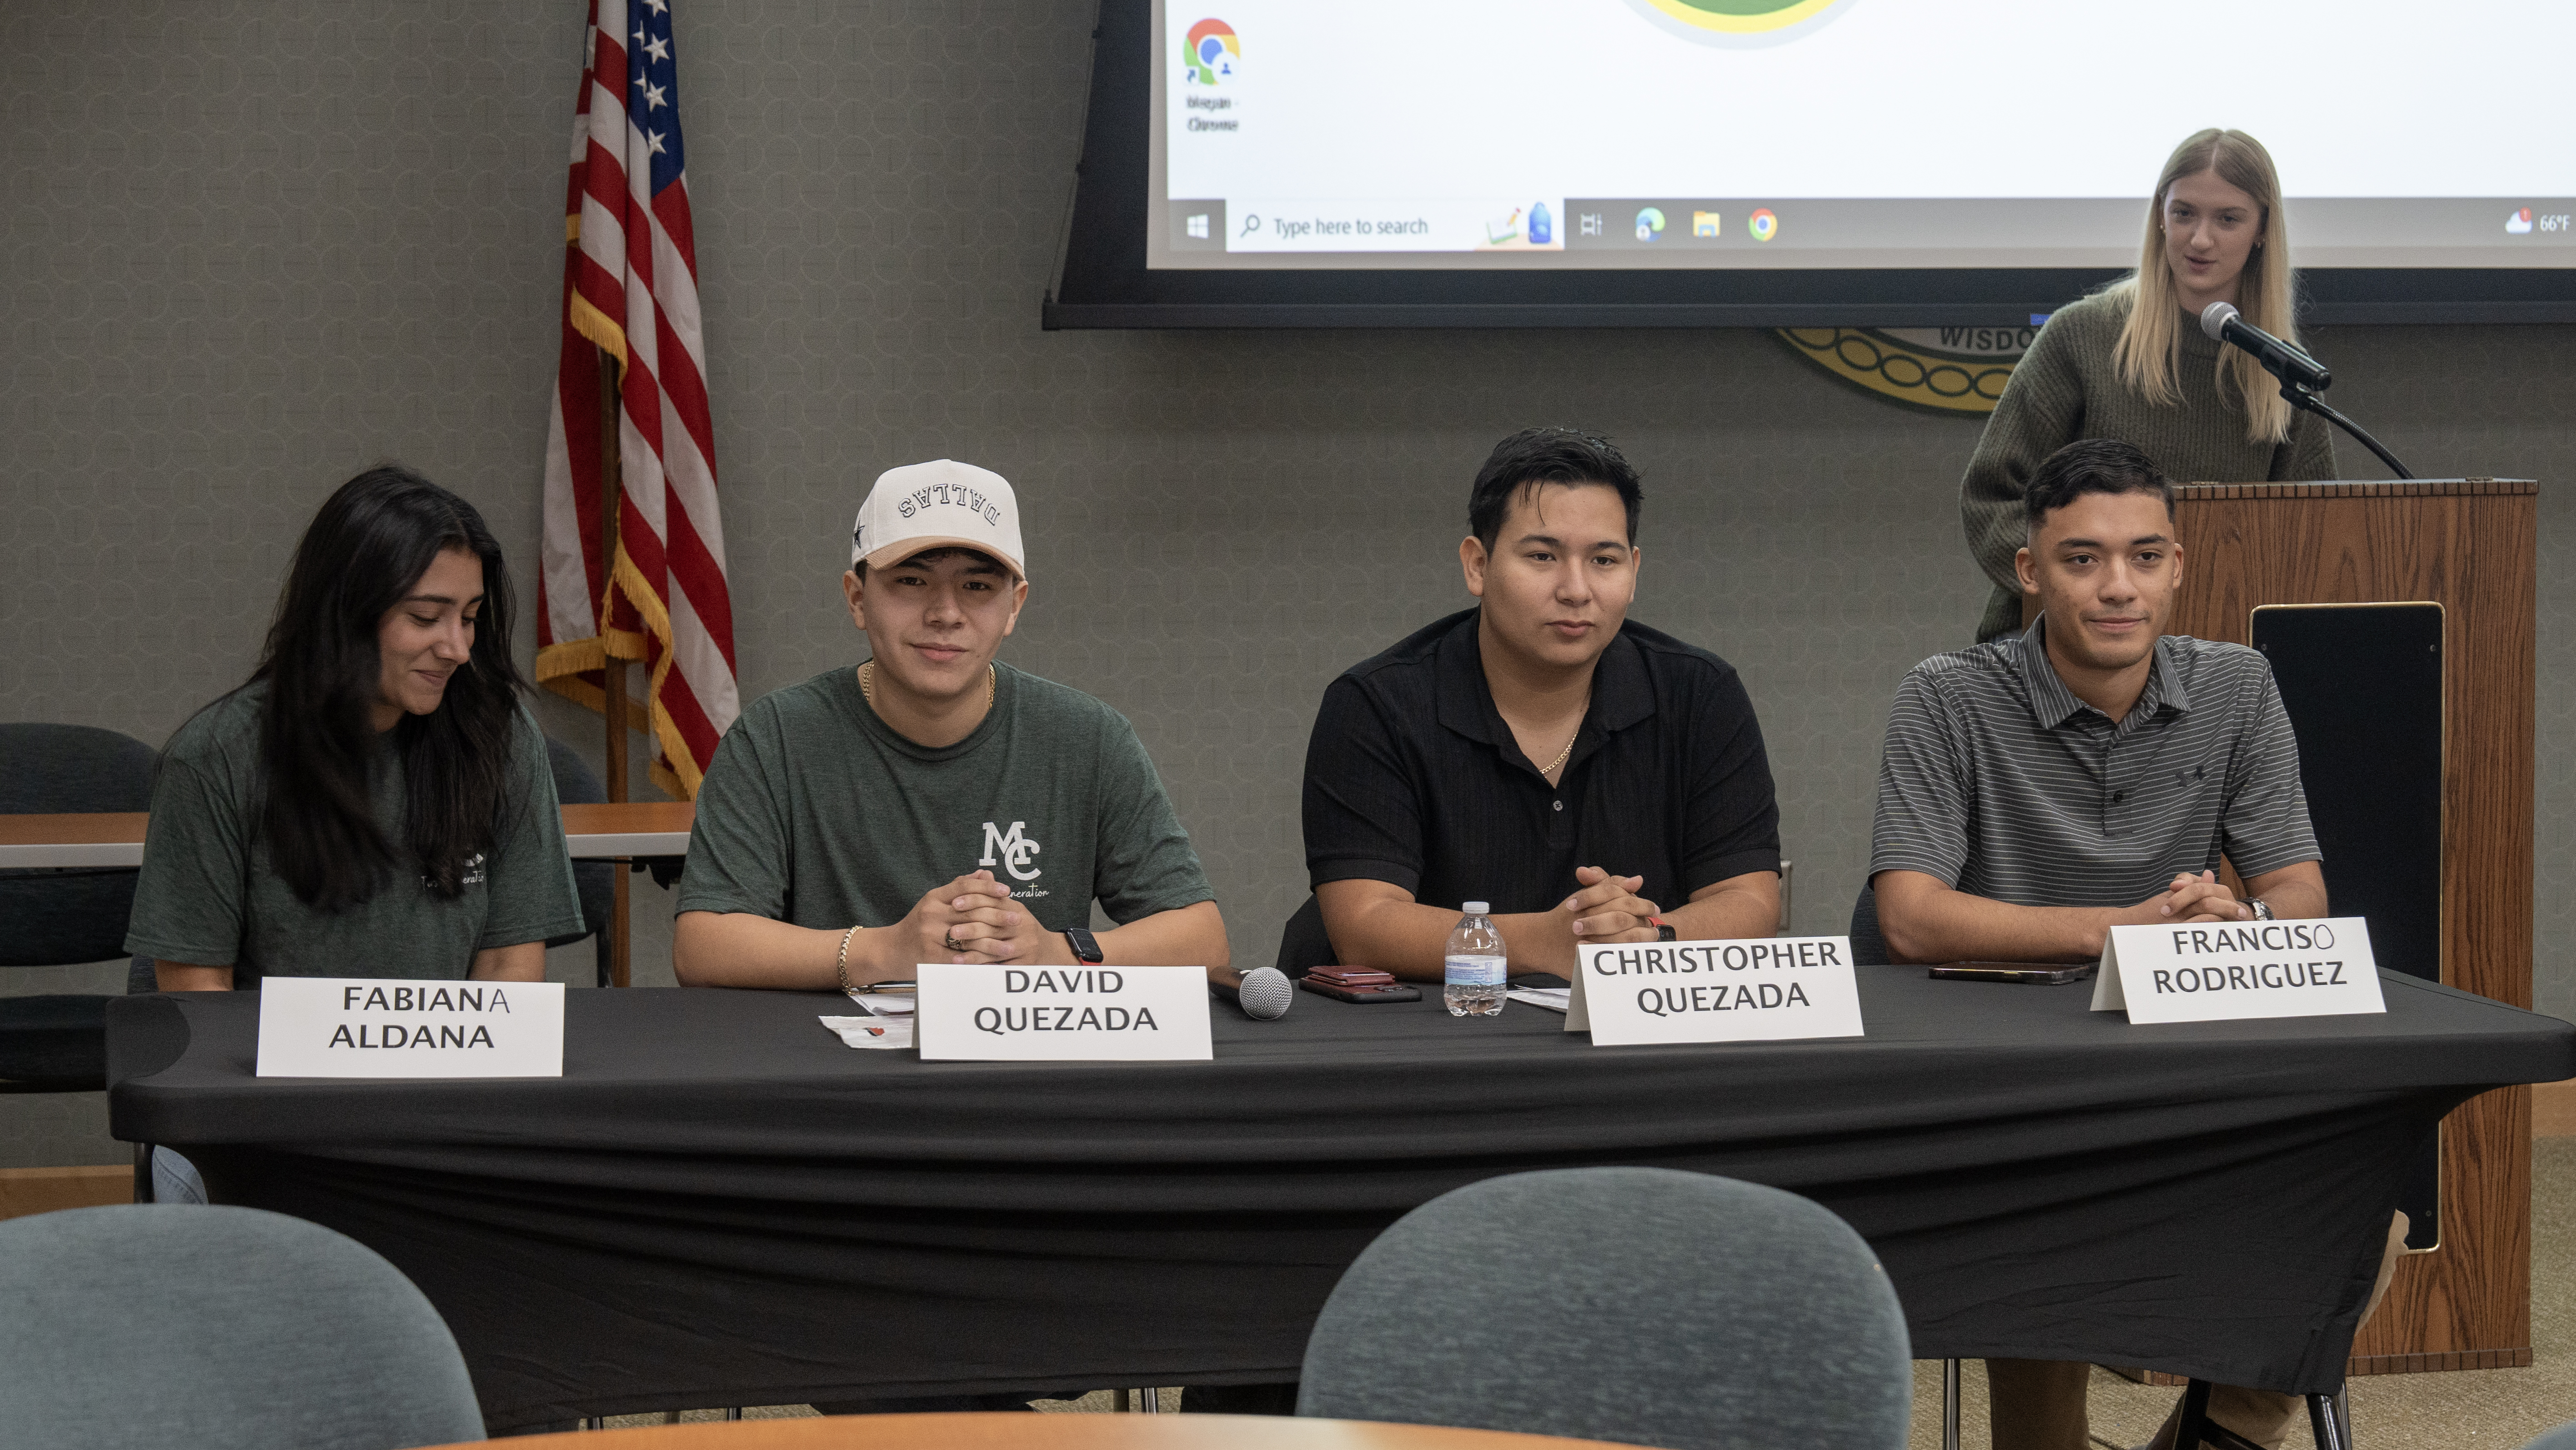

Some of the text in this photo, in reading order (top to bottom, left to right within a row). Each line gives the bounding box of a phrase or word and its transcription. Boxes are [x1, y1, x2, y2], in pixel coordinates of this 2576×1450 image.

[1273, 218, 1428, 239] Type here to search
[1940, 325, 2036, 351] WISDO
[898, 483, 1001, 526] DALLAS
[1008, 883, 1049, 898] neration
[2172, 924, 2335, 955] FRANCISO
[1593, 941, 1842, 976] CHRISTOPHER
[1005, 970, 1124, 993] DAVID
[2153, 961, 2347, 994] RODRIGUEZ
[343, 986, 510, 1013] FABIANA
[1637, 982, 1810, 1018] QUEZADA
[974, 1007, 1159, 1036] QUEZADA
[328, 1024, 495, 1049] ALDANA
